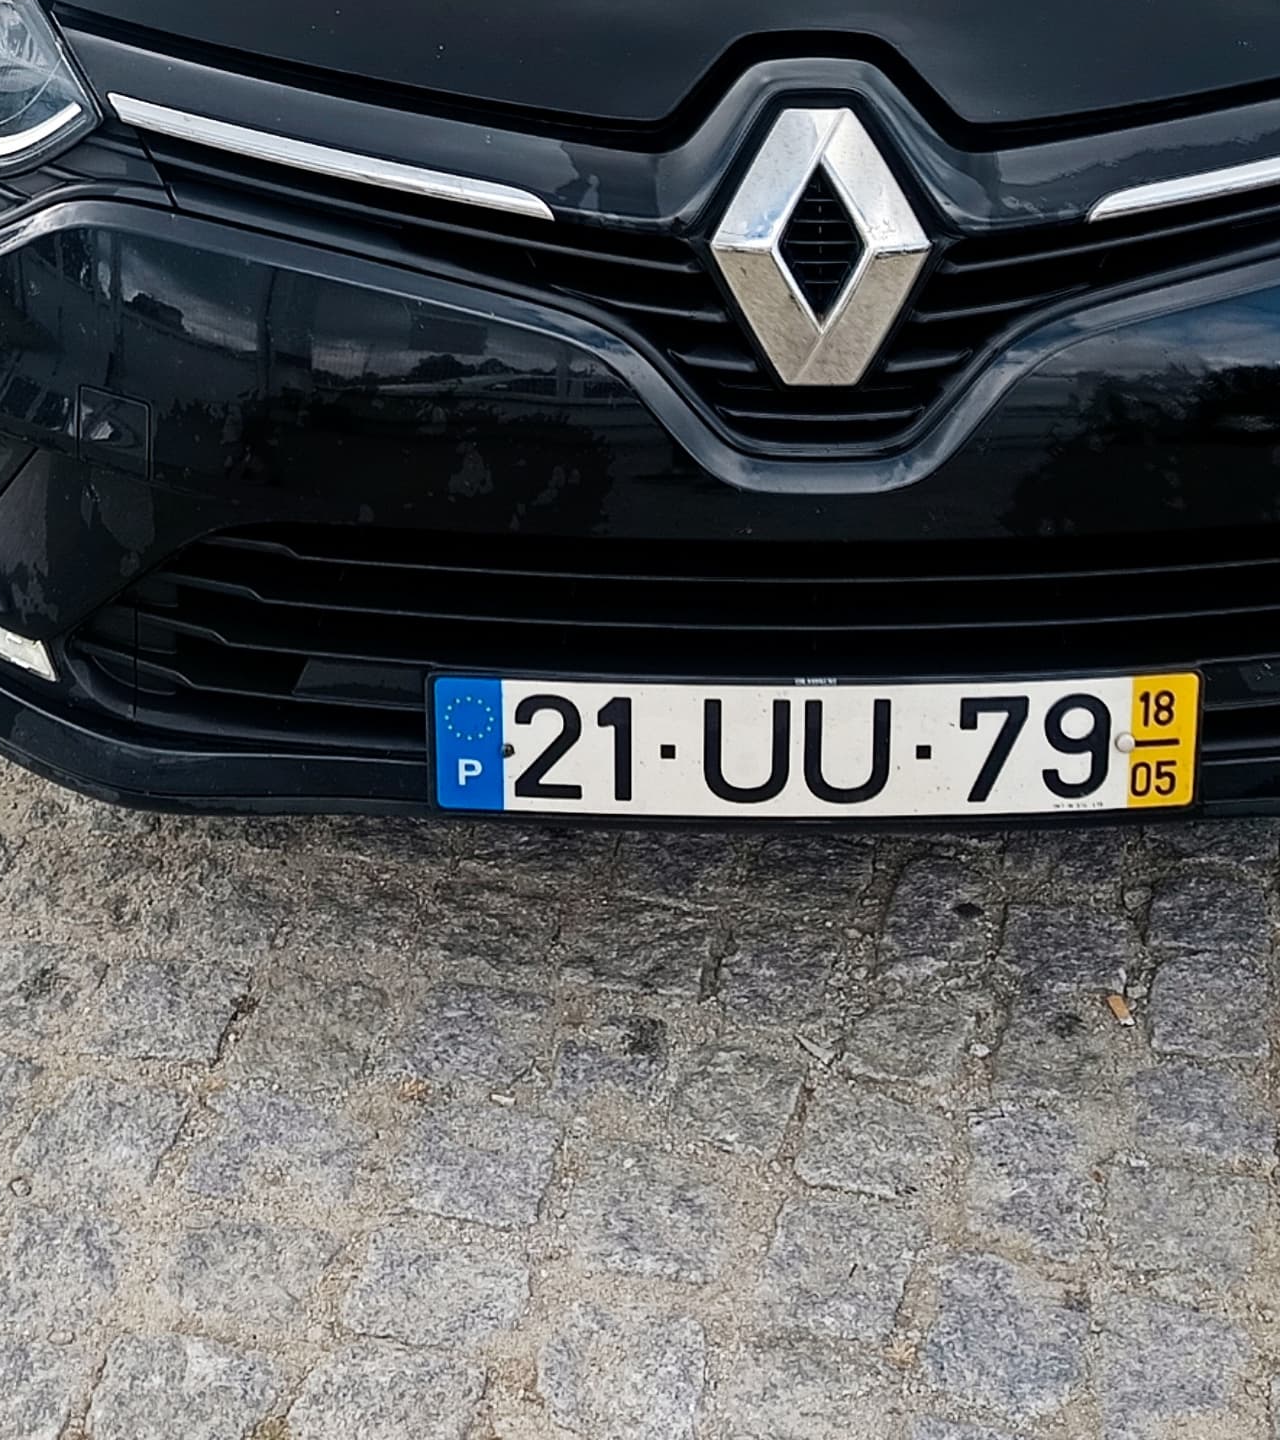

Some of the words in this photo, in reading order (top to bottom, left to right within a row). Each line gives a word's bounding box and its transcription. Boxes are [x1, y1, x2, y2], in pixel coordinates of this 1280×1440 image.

[1139, 690, 1175, 727] 18
[458, 759, 483, 786] P
[1130, 761, 1177, 797] 05
